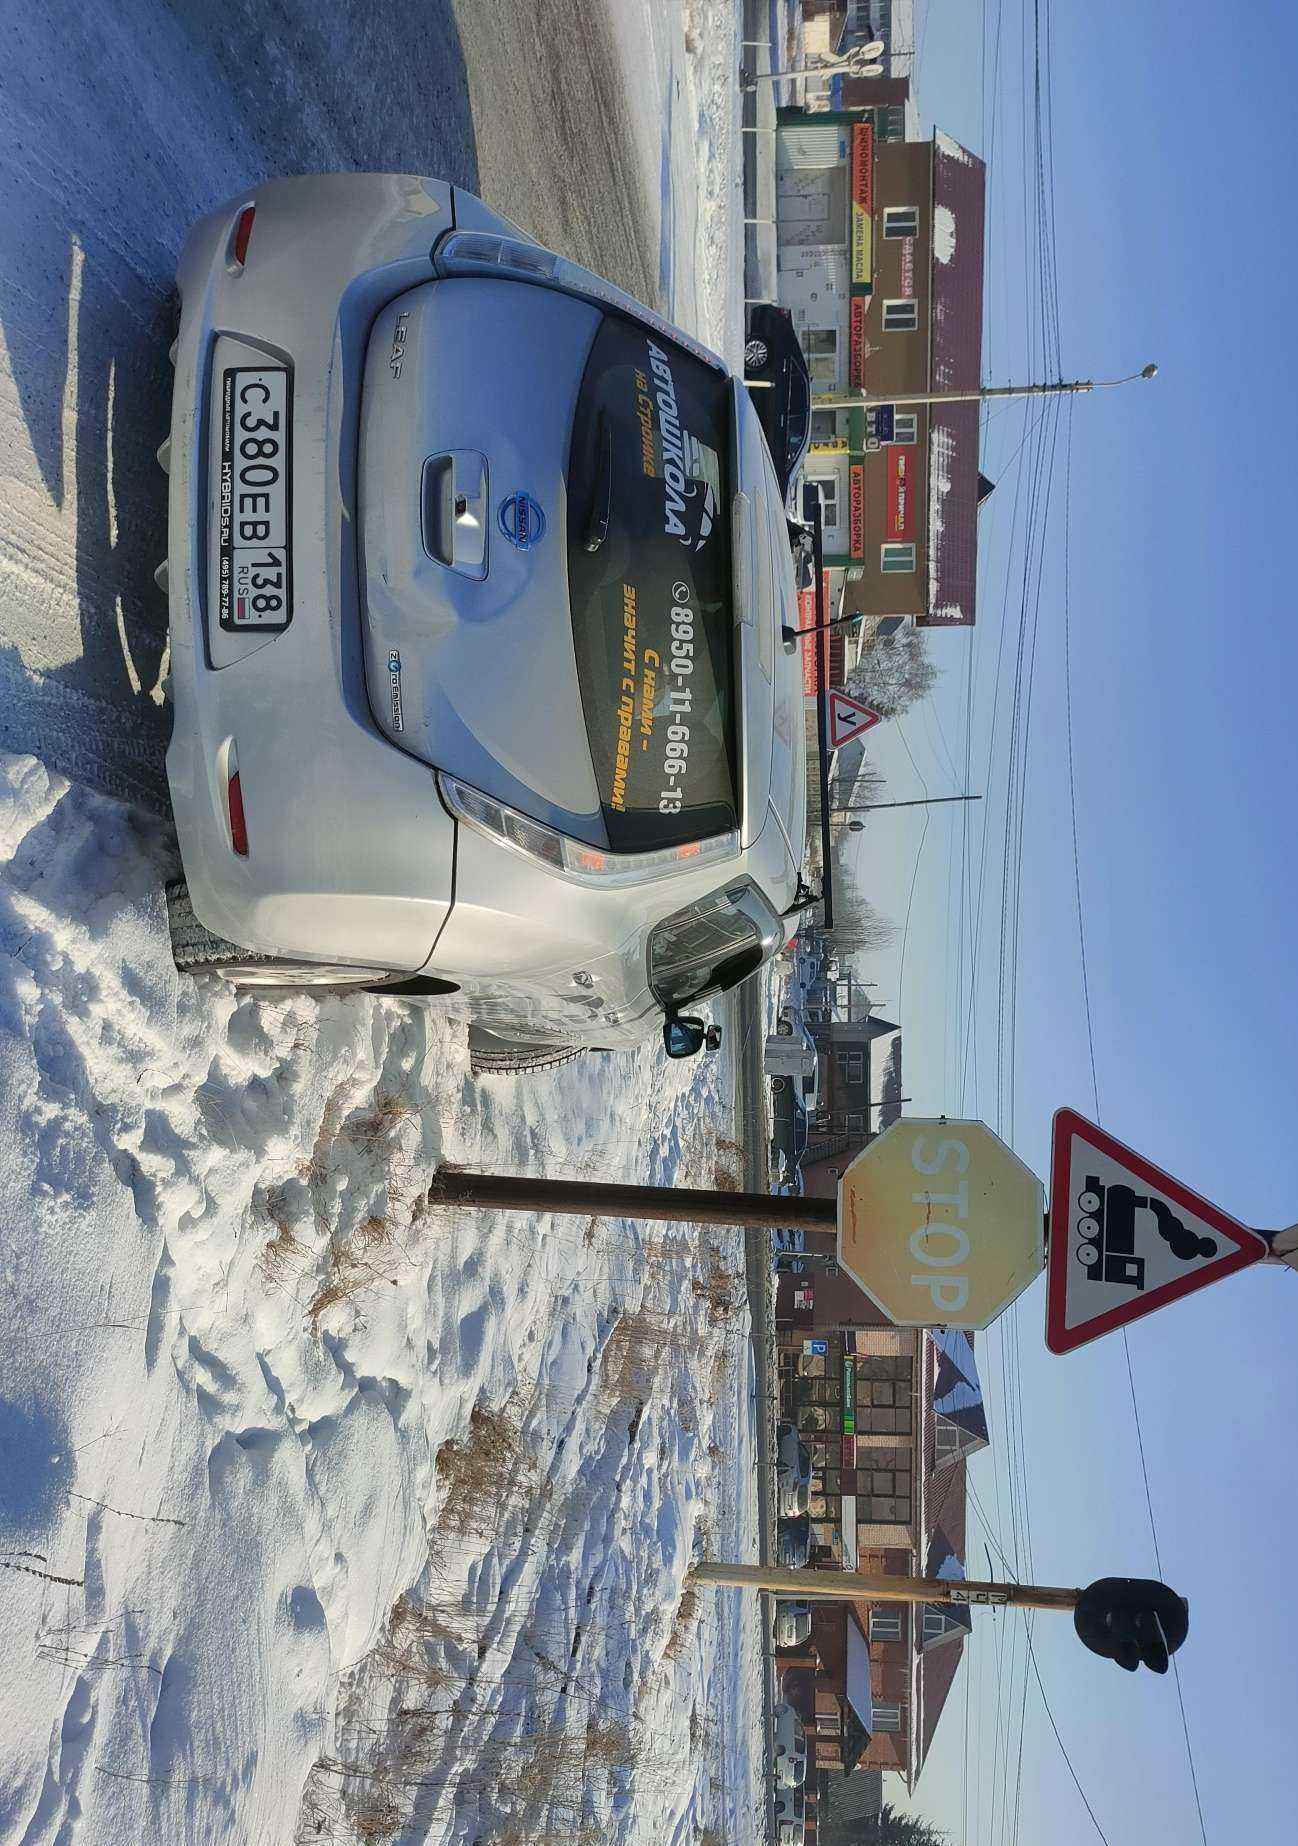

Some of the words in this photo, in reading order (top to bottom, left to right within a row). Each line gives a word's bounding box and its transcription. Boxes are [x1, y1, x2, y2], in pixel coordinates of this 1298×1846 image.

[858, 127, 869, 205] ШИНОМОНТАЖ
[855, 212, 865, 247] ЗАМЕНА
[855, 250, 865, 280] МАСЛА
[389, 311, 412, 380] LEAF
[852, 304, 863, 388] АВТОРАЗБОРКА
[633, 367, 648, 390] на
[647, 339, 686, 536] АВТОШКОЛА
[517, 496, 529, 543] NISSAN
[852, 471, 862, 553] АВТОРАЗБОРКА
[221, 557, 230, 577] (495)
[237, 566, 249, 596] RUS
[250, 551, 283, 613] 138
[220, 580, 229, 619] 789-77-86
[622, 584, 638, 676] значит
[621, 678, 635, 694] с
[643, 649, 660, 668] С
[640, 669, 658, 736] нами
[658, 606, 694, 815] 8950-11-666-13
[610, 695, 636, 814] правами!
[909, 1134, 970, 1312] STOP
[813, 1344, 826, 1353] P
